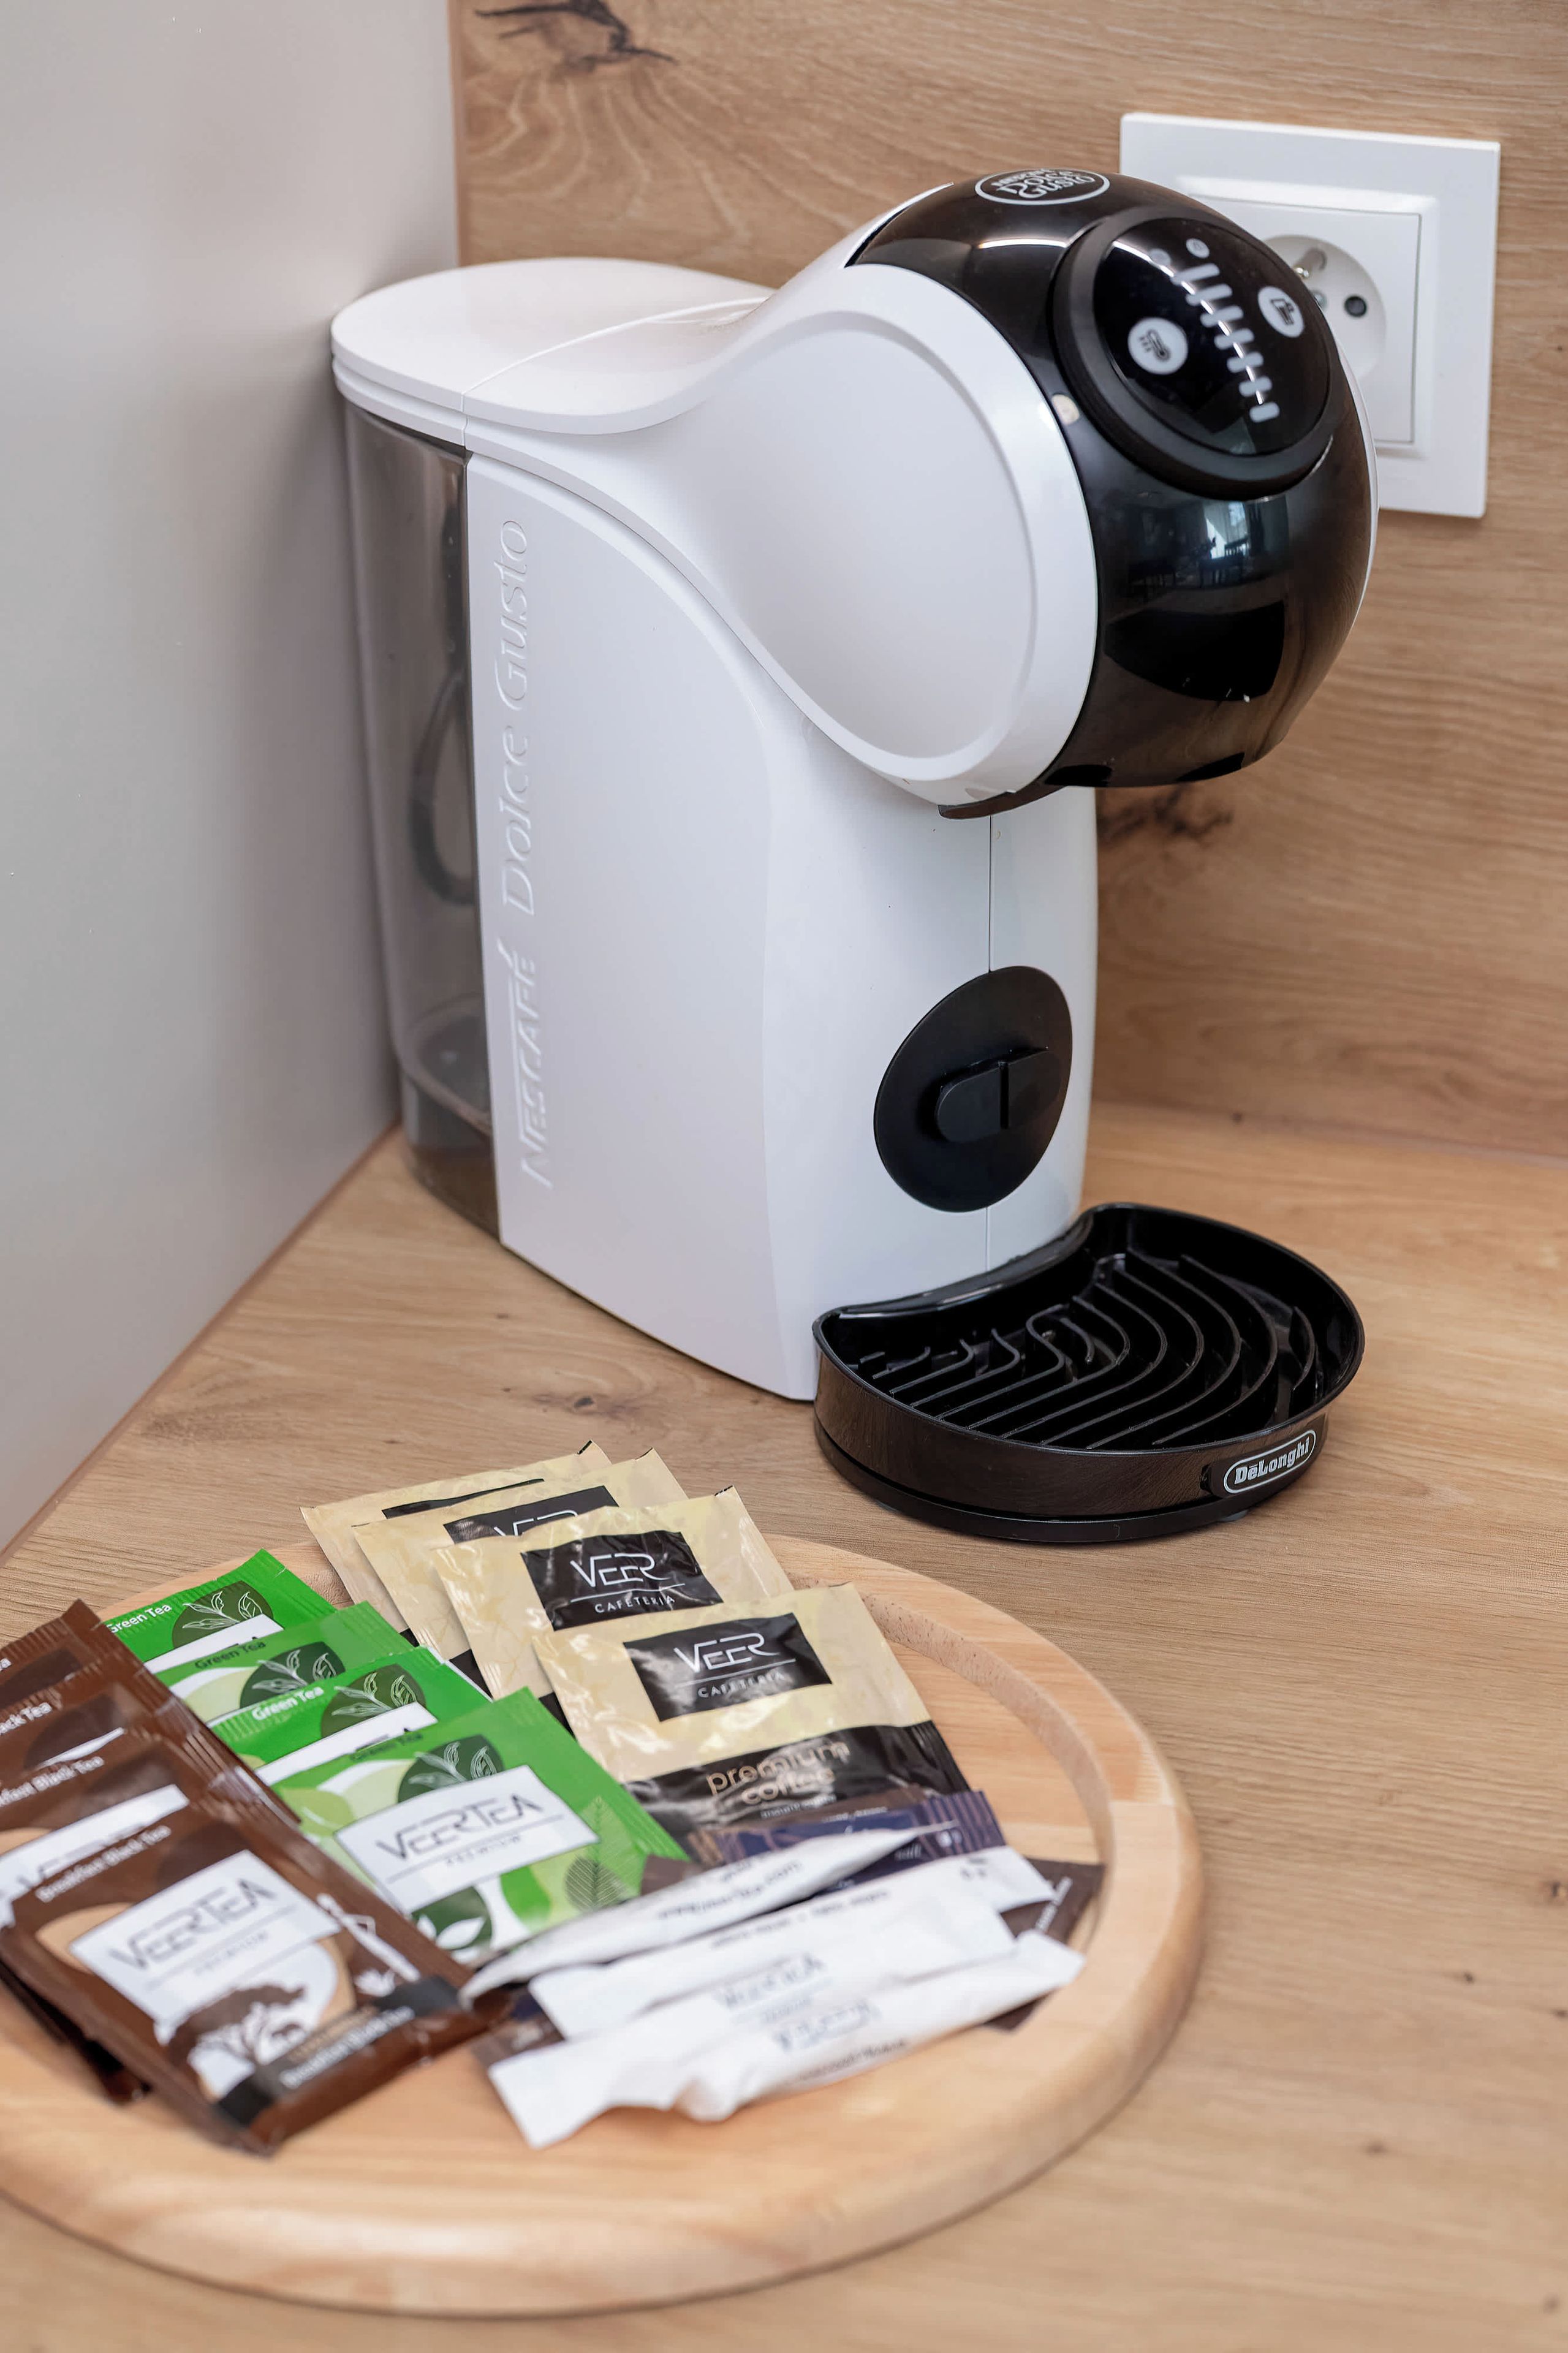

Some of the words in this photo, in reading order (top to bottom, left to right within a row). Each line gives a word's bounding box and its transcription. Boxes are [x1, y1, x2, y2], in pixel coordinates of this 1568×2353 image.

[494, 520, 528, 711] Gusto
[499, 725, 536, 917] Dolce
[106, 1614, 148, 1634] Green
[146, 1603, 173, 1621] Tea
[594, 1594, 676, 1614] CAFETERIA
[194, 1647, 240, 1670] Green
[237, 1640, 267, 1656] Tea
[20, 1702, 52, 1721] Tea
[251, 1697, 298, 1722] Green
[295, 1685, 325, 1706] Tea
[705, 1741, 852, 1795] premium
